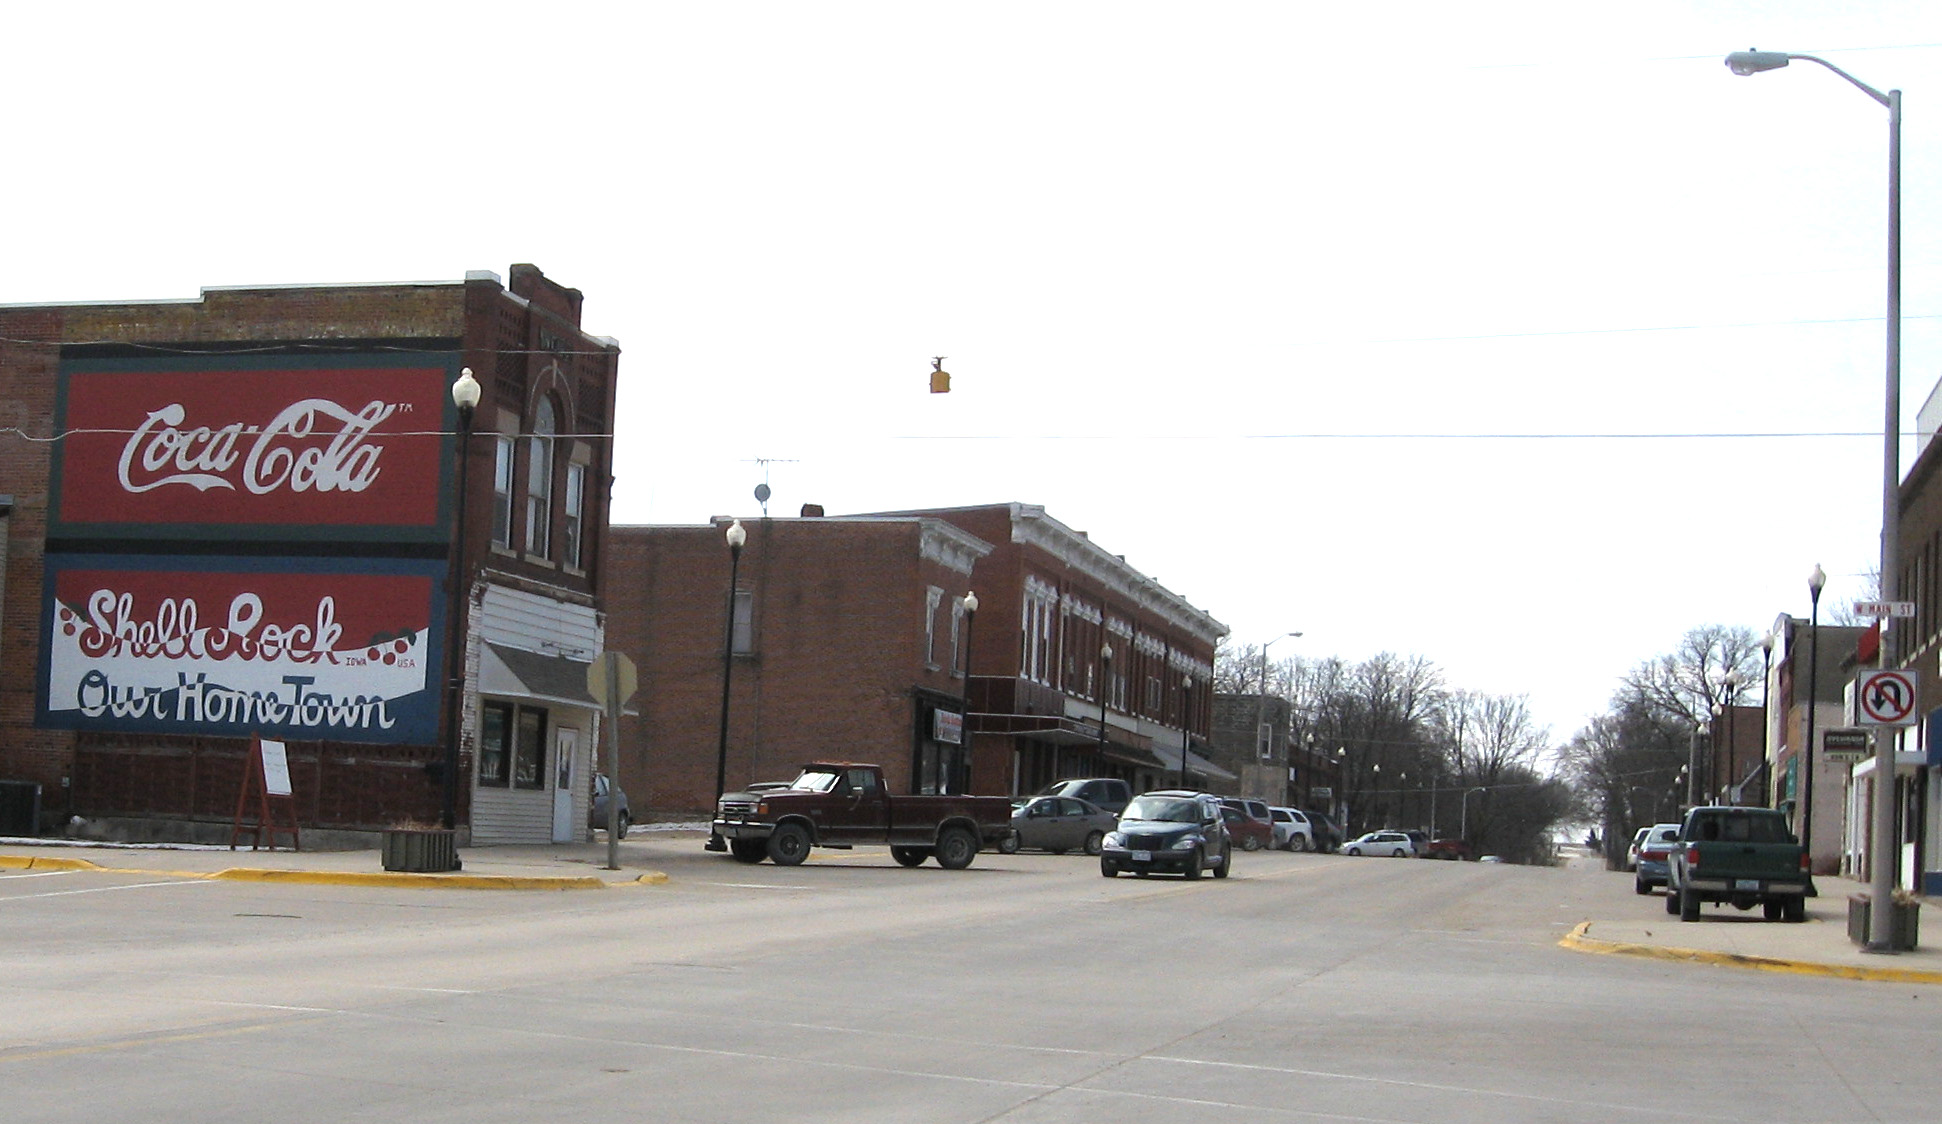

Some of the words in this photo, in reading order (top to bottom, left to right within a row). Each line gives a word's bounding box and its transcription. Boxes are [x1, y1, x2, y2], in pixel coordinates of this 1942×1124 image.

[118, 398, 396, 495] Coca-Cola
[79, 588, 203, 658] Shell
[204, 592, 344, 664] Rock
[1855, 604, 1864, 614] W
[1868, 604, 1892, 615] MAIN
[1900, 604, 1912, 616] ST
[345, 656, 368, 667] IOWA
[397, 658, 416, 669] USA
[77, 669, 169, 719] Our
